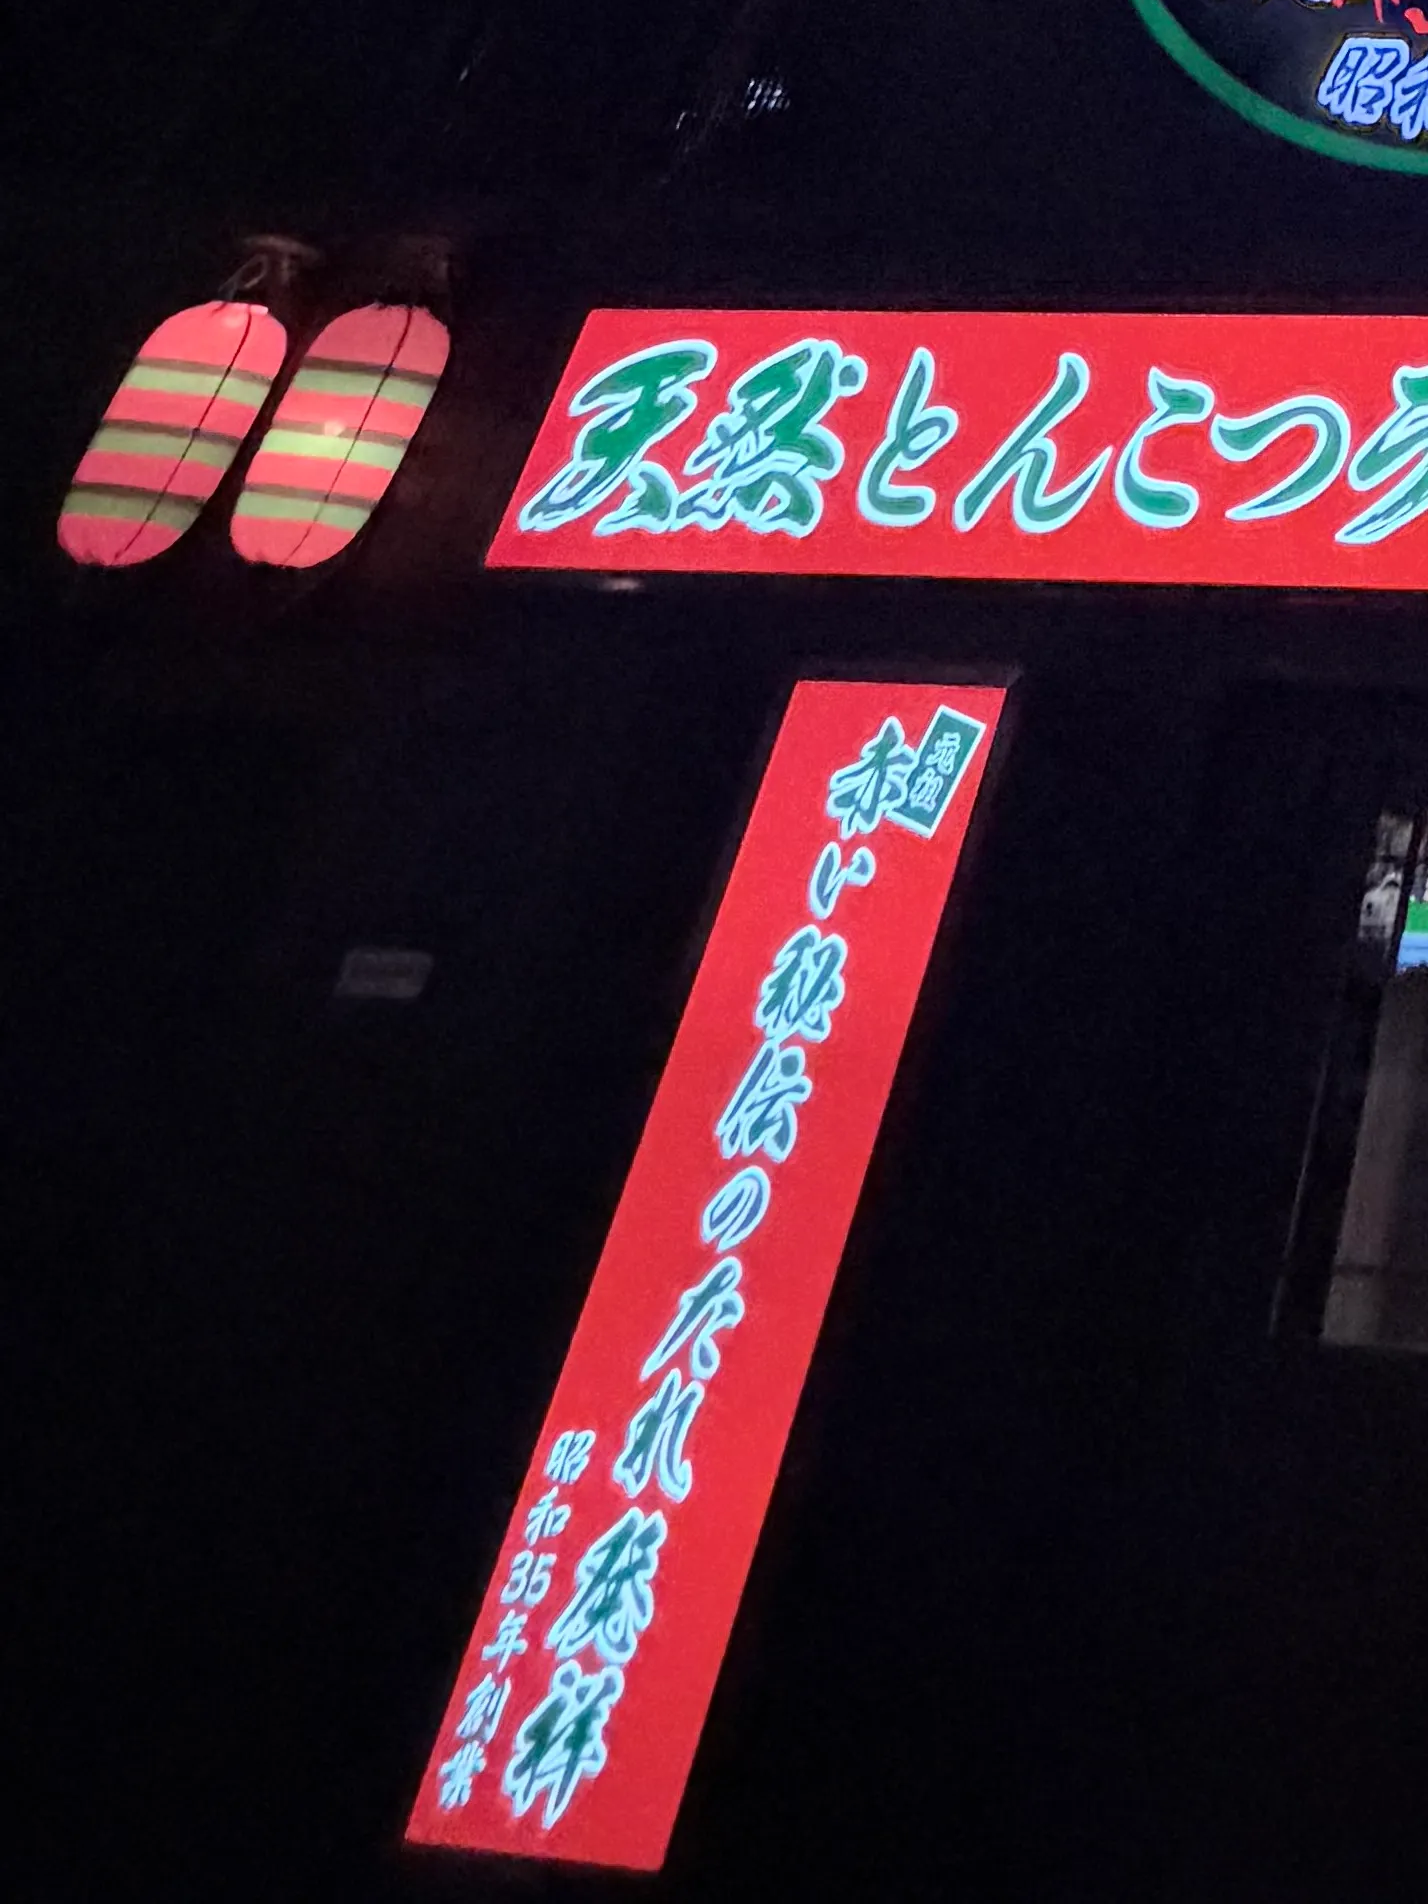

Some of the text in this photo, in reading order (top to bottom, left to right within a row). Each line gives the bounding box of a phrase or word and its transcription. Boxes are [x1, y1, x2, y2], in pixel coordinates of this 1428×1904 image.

[437, 1428, 597, 1811] 昭和35年創業
